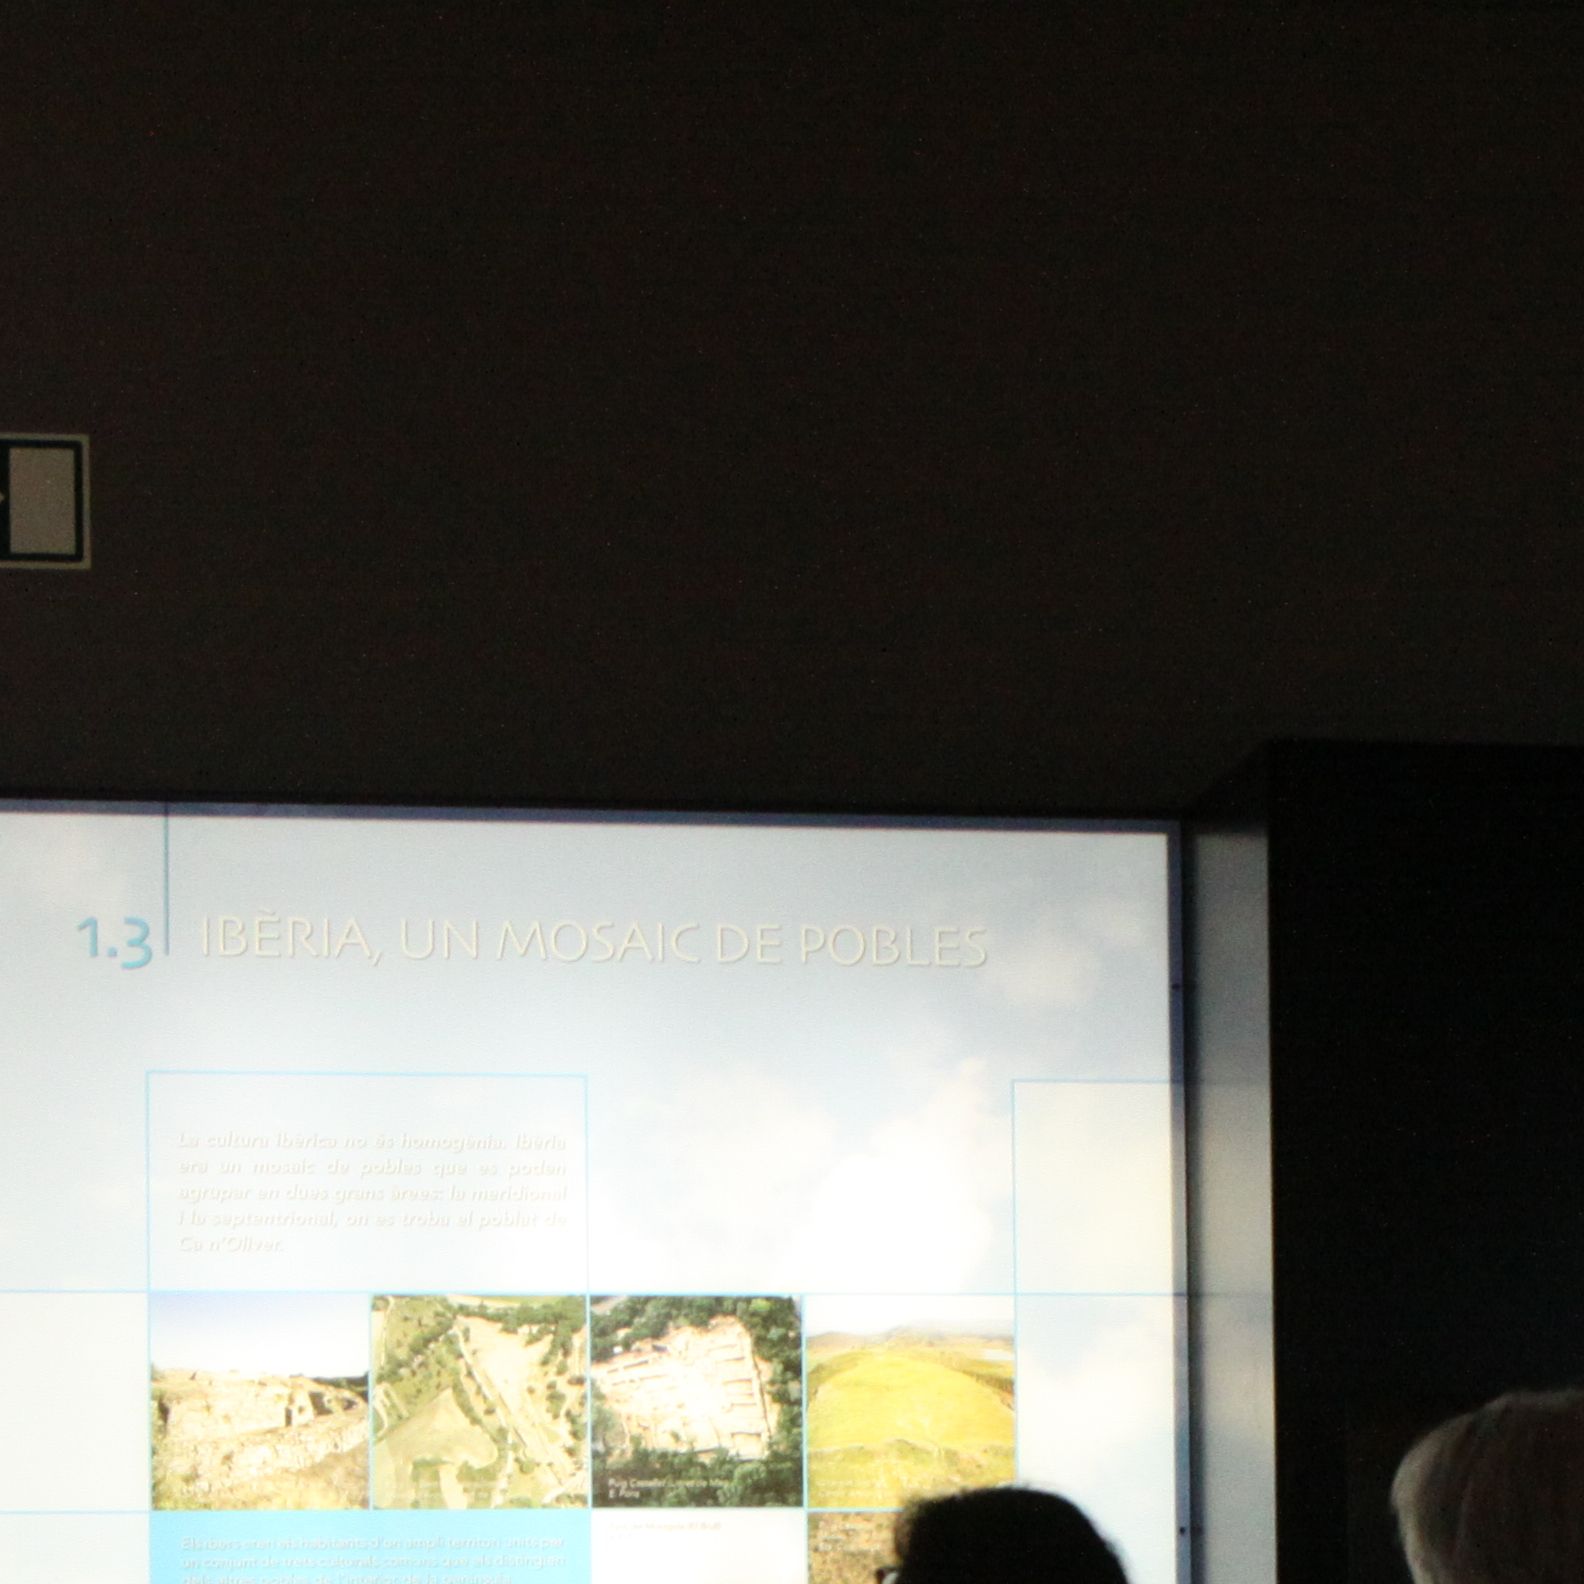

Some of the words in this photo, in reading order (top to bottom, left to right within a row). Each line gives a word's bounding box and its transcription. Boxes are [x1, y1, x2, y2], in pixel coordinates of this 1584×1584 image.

[76, 915, 153, 971] 1.3
[201, 910, 385, 967] IBÈRIA,
[400, 918, 479, 960] UN
[495, 918, 702, 963] MOSAIC
[716, 923, 784, 965] DE
[801, 924, 989, 968] POBLES
[178, 1131, 200, 1149] La
[207, 1131, 269, 1149] cultura
[344, 1136, 368, 1149] no
[179, 1160, 209, 1175] era
[219, 1160, 242, 1175] un
[253, 1158, 316, 1175] mosaic
[327, 1158, 350, 1175] de
[360, 1158, 423, 1179] pobles
[432, 1162, 467, 1179] que
[478, 1163, 499, 1176] es
[508, 1159, 567, 1179] poden
[178, 1186, 253, 1204] agrupar
[258, 1188, 280, 1201] en
[286, 1184, 329, 1201] dues
[334, 1187, 385, 1205] grans
[472, 1184, 568, 1201] meridional
